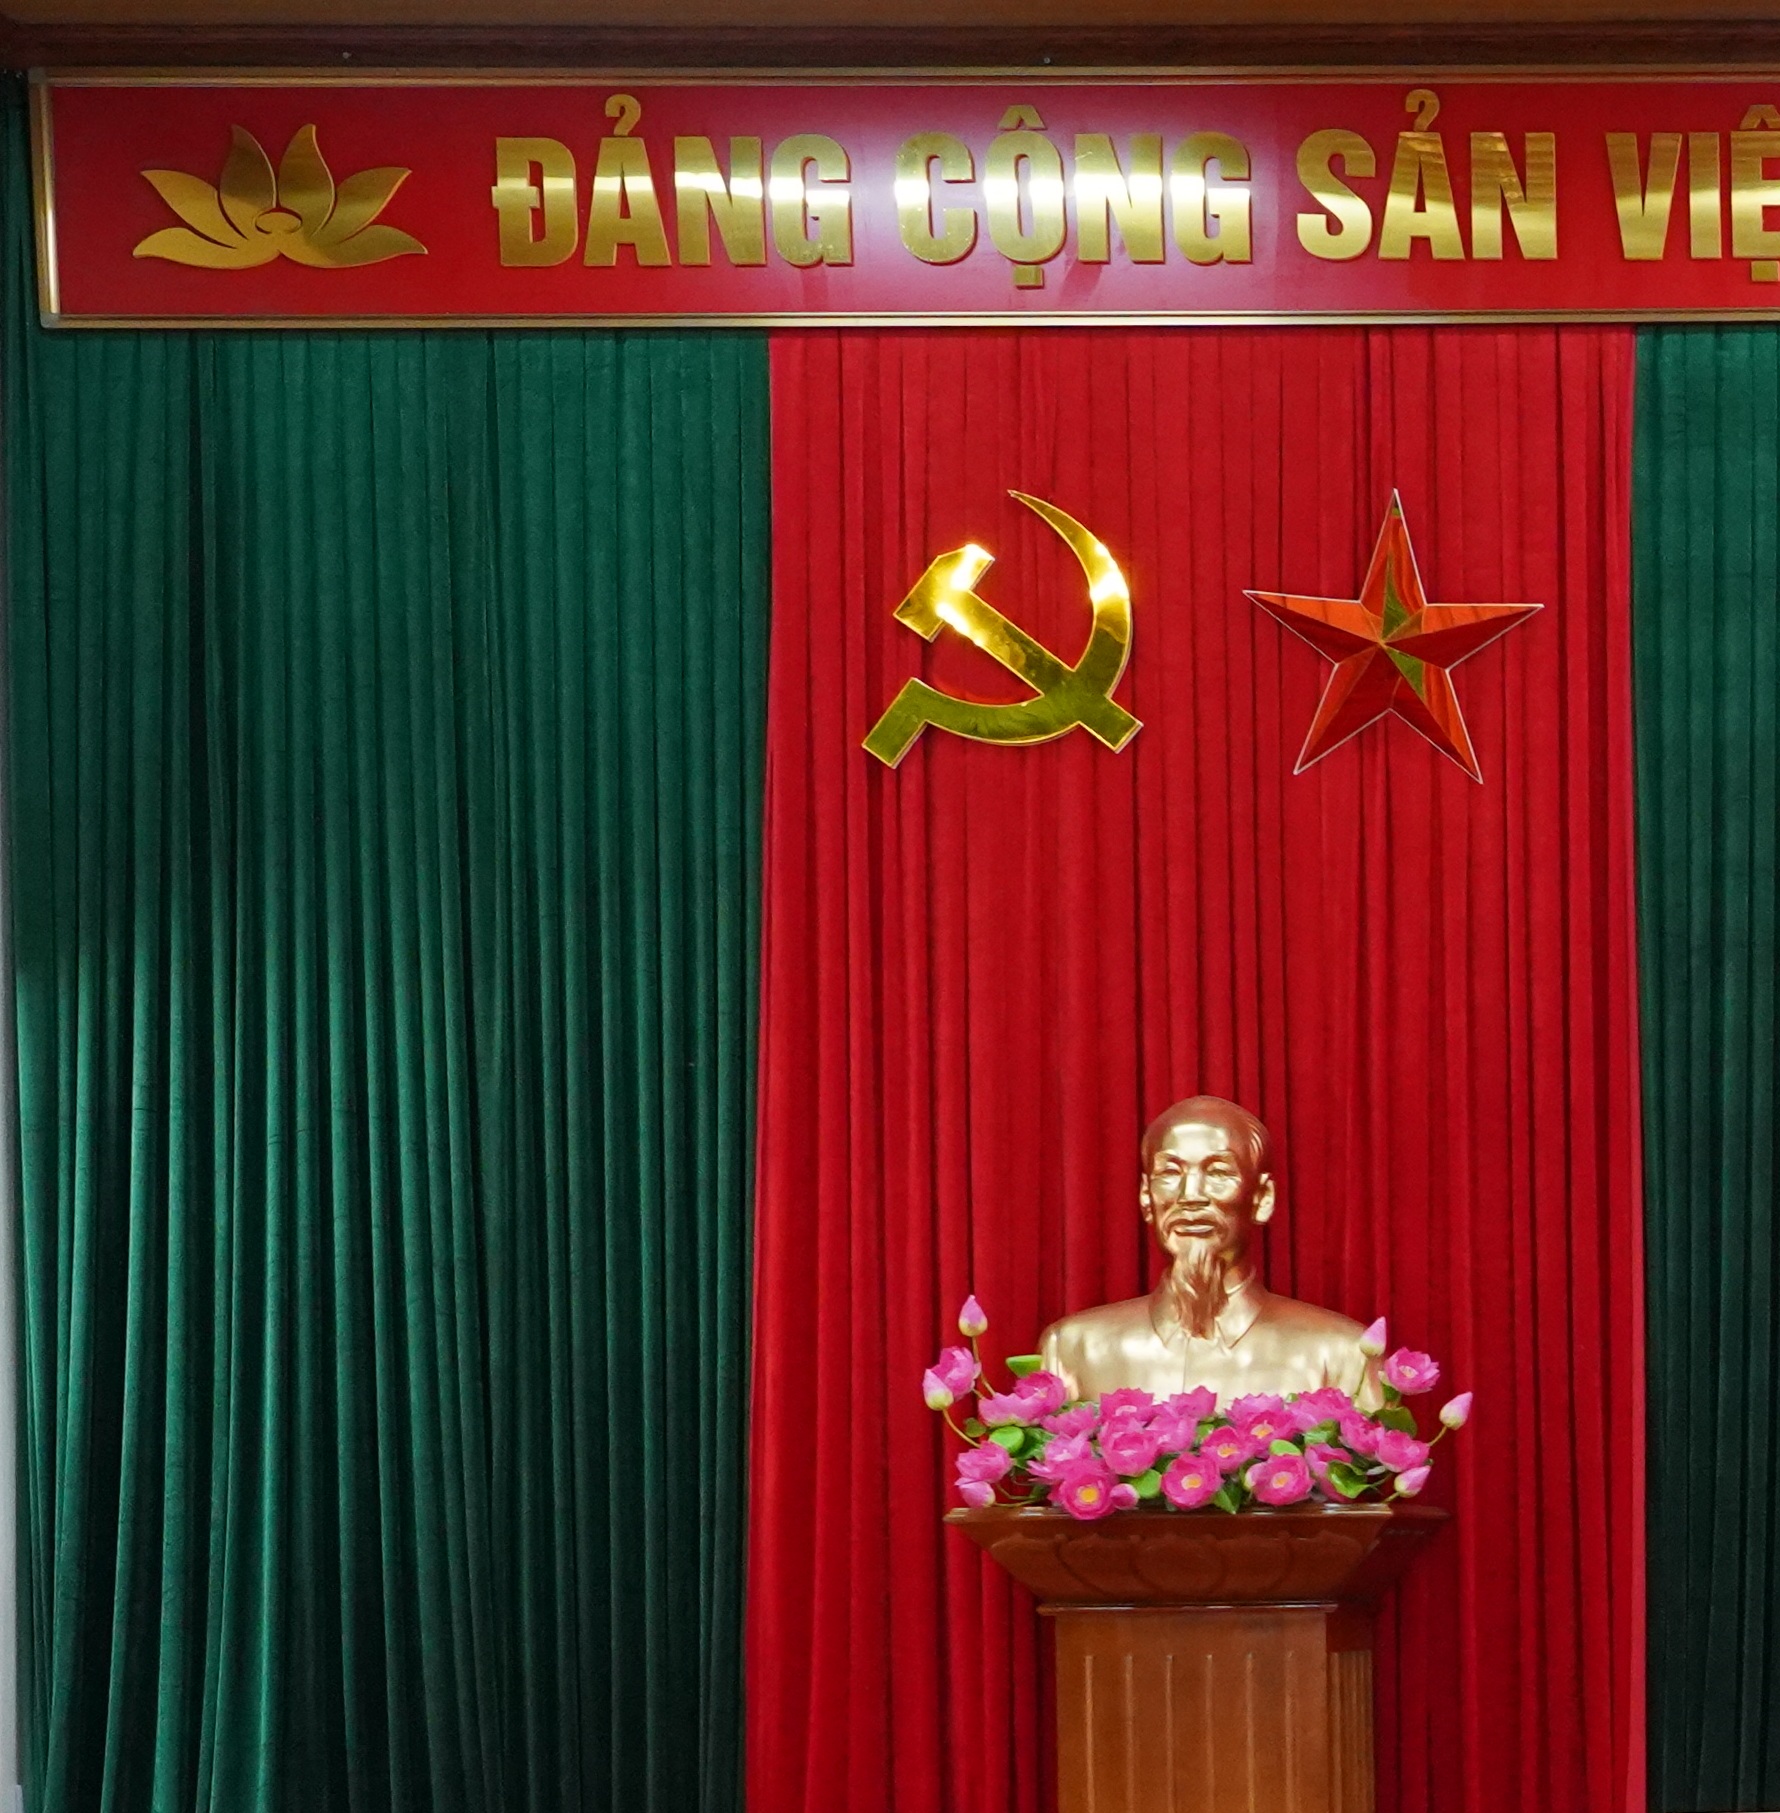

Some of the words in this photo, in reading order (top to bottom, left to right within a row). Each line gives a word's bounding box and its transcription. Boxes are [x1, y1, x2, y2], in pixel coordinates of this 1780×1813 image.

[492, 94, 852, 266] ĐẢNG
[894, 104, 1252, 289] CỘNG
[1296, 89, 1557, 261] SẢN
